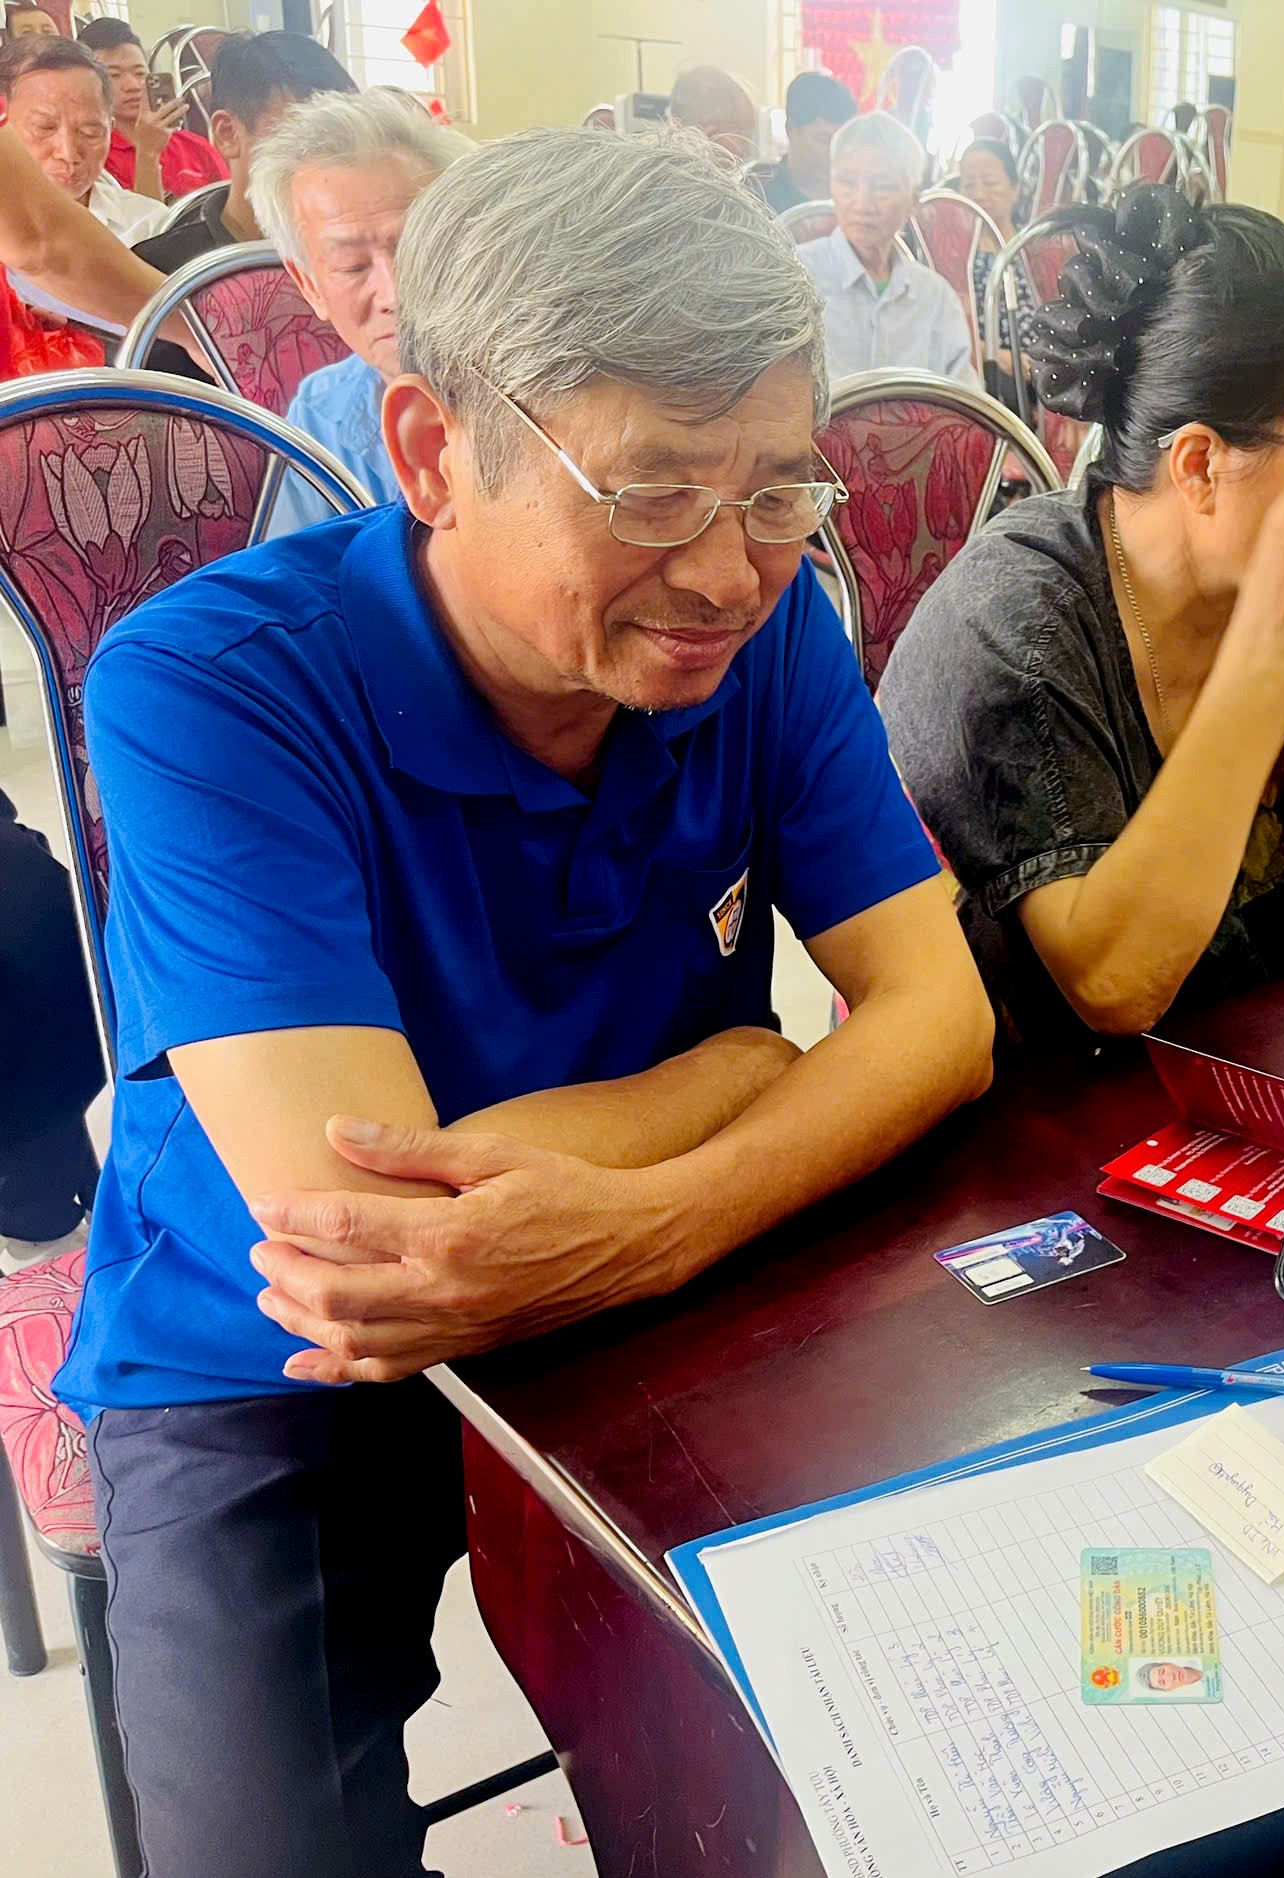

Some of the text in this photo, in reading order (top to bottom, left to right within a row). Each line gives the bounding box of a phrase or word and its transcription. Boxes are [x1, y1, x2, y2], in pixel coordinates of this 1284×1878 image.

[829, 1712, 850, 1739] SÁCH
[842, 1738, 863, 1768] DANH
[917, 1777, 929, 1794] Tên
[929, 1804, 941, 1818] Họ
[955, 1859, 968, 1873] TT
